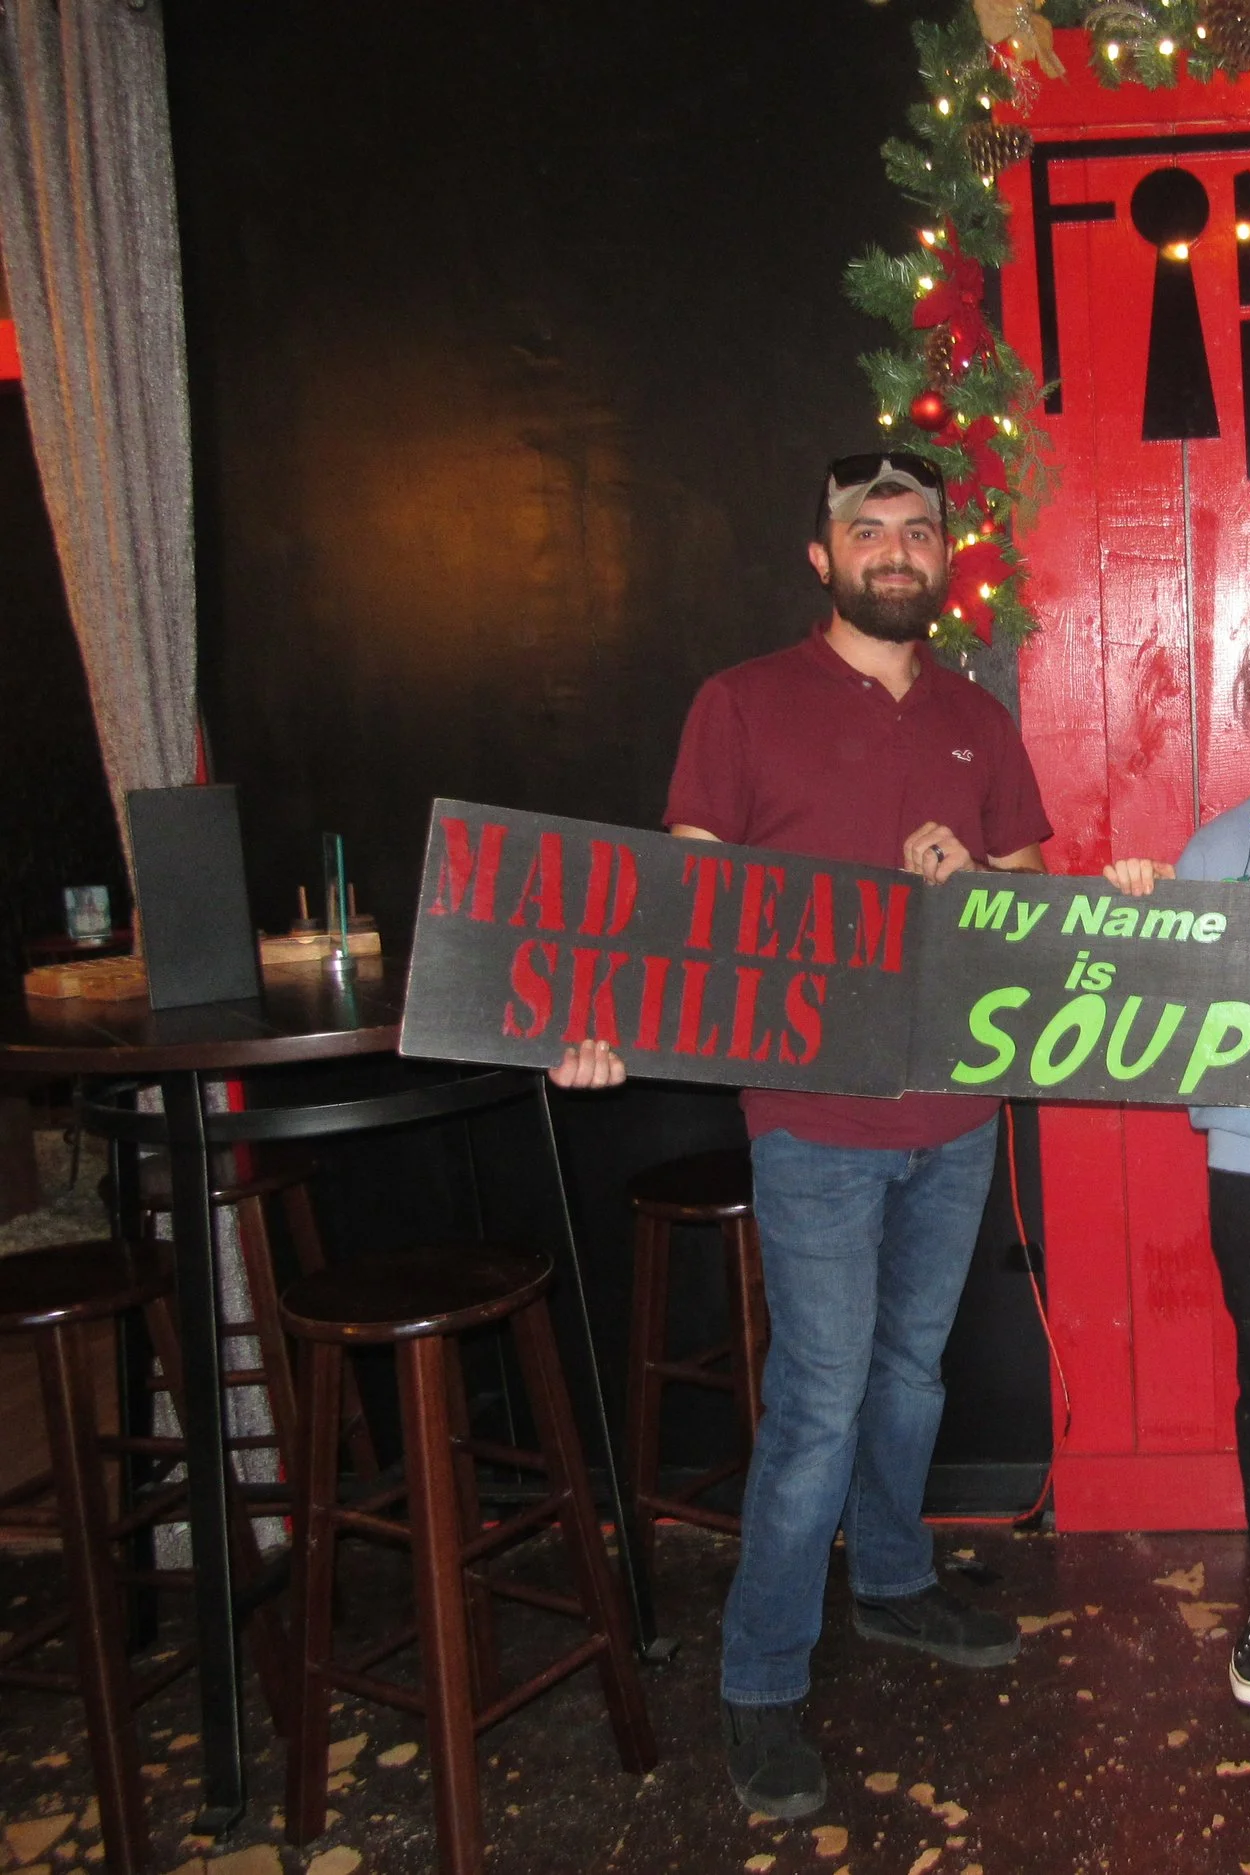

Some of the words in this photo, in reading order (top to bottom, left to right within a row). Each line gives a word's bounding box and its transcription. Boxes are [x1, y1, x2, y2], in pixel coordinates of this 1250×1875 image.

[427, 817, 638, 937] MAD
[682, 854, 912, 974] TEAM
[957, 889, 1050, 941] My
[1061, 895, 1227, 943] Name
[503, 938, 827, 1065] SKILLS
[1064, 950, 1117, 992] is
